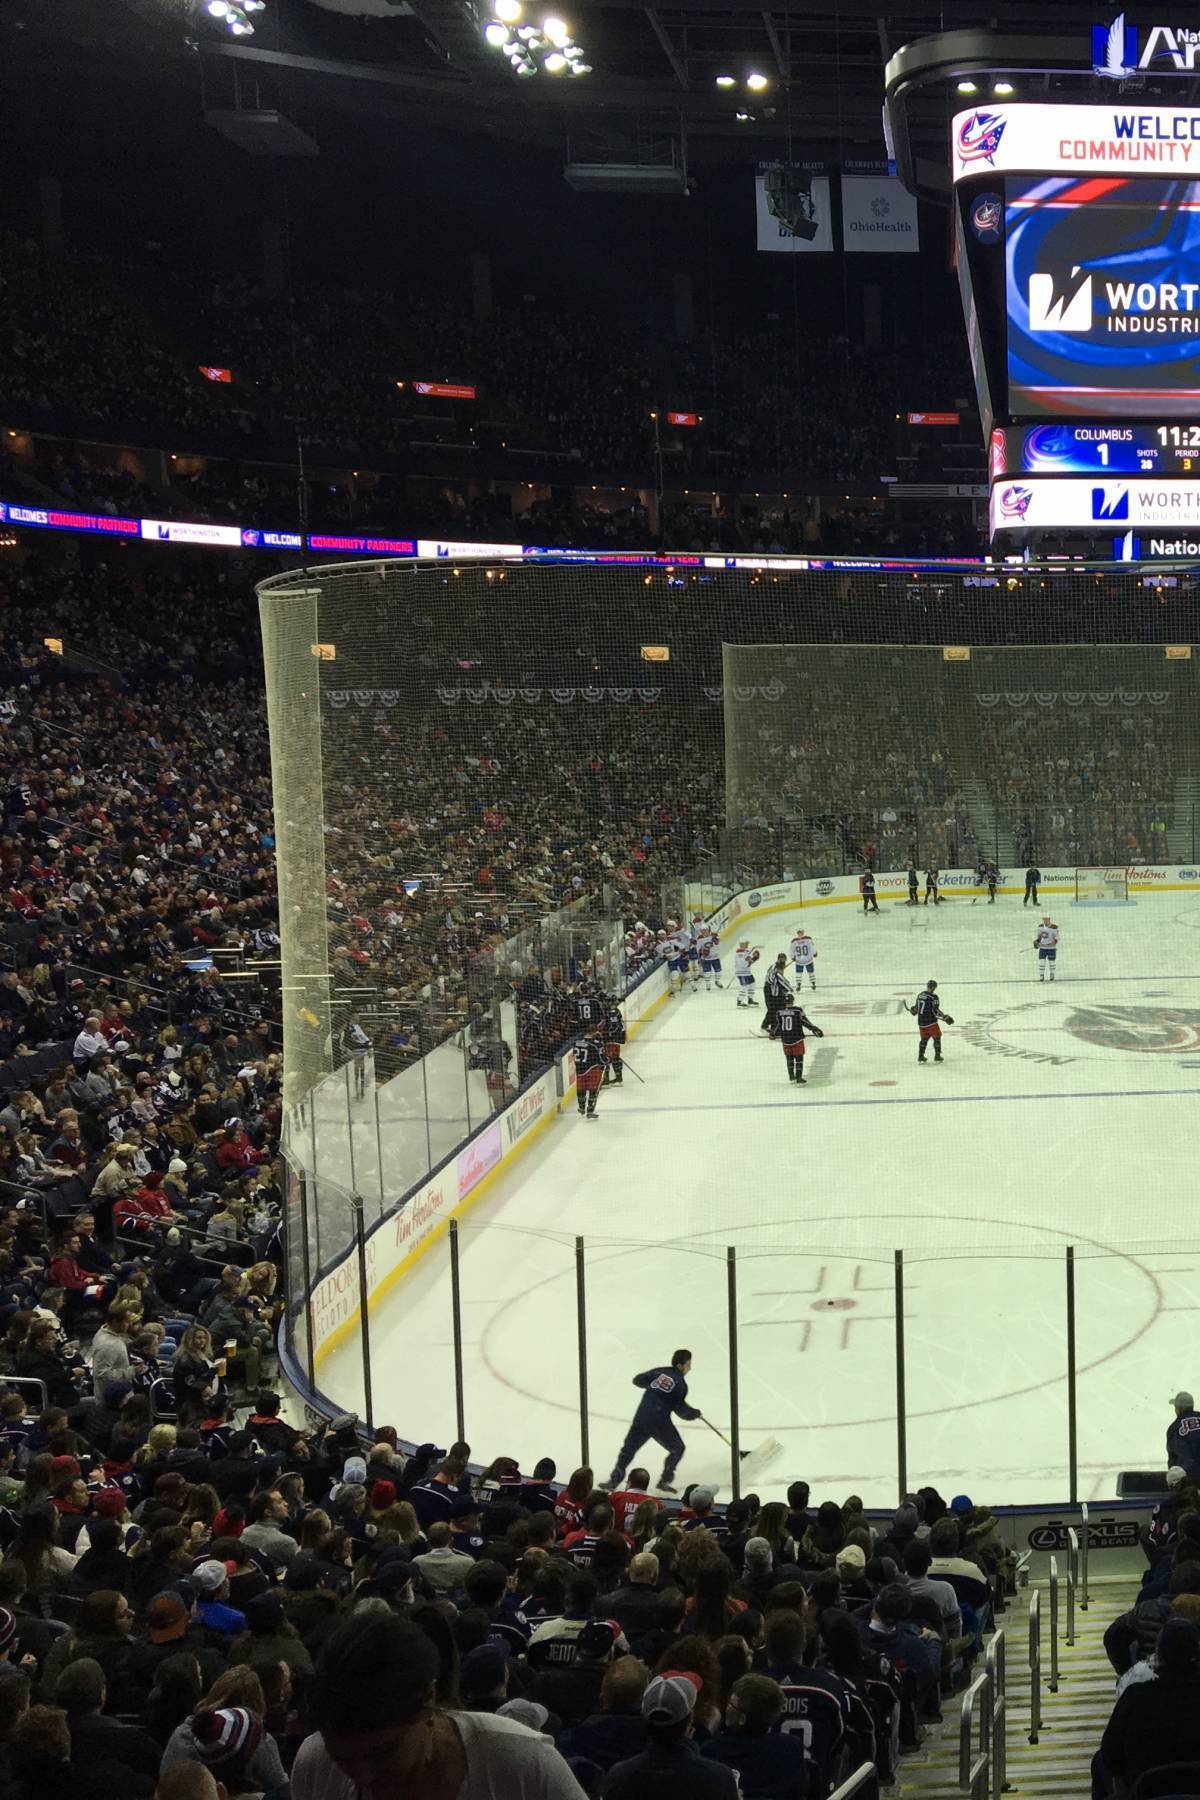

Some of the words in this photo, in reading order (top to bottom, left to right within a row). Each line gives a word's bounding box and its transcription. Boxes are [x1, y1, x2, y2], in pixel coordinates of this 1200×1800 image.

[1059, 140, 1192, 164] COMMUNITY
[849, 221, 912, 232] OhioHealth
[1074, 429, 1133, 441] COLUMBUS
[1096, 443, 1109, 466] 1
[1136, 449, 1158, 457] SHOTS
[1175, 449, 1199, 457] PERIOD
[1183, 459, 1191, 470] 3
[9, 506, 48, 523] WELCOMES
[310, 536, 366, 550] COMMUNITY
[367, 540, 414, 552] PARTNERS
[1126, 866, 1167, 880] Hortons
[781, 1015, 793, 1032] 10
[394, 1209, 412, 1248] Tim
[413, 1188, 444, 1233] Hortons
[1101, 1537, 1137, 1547] SEATS
